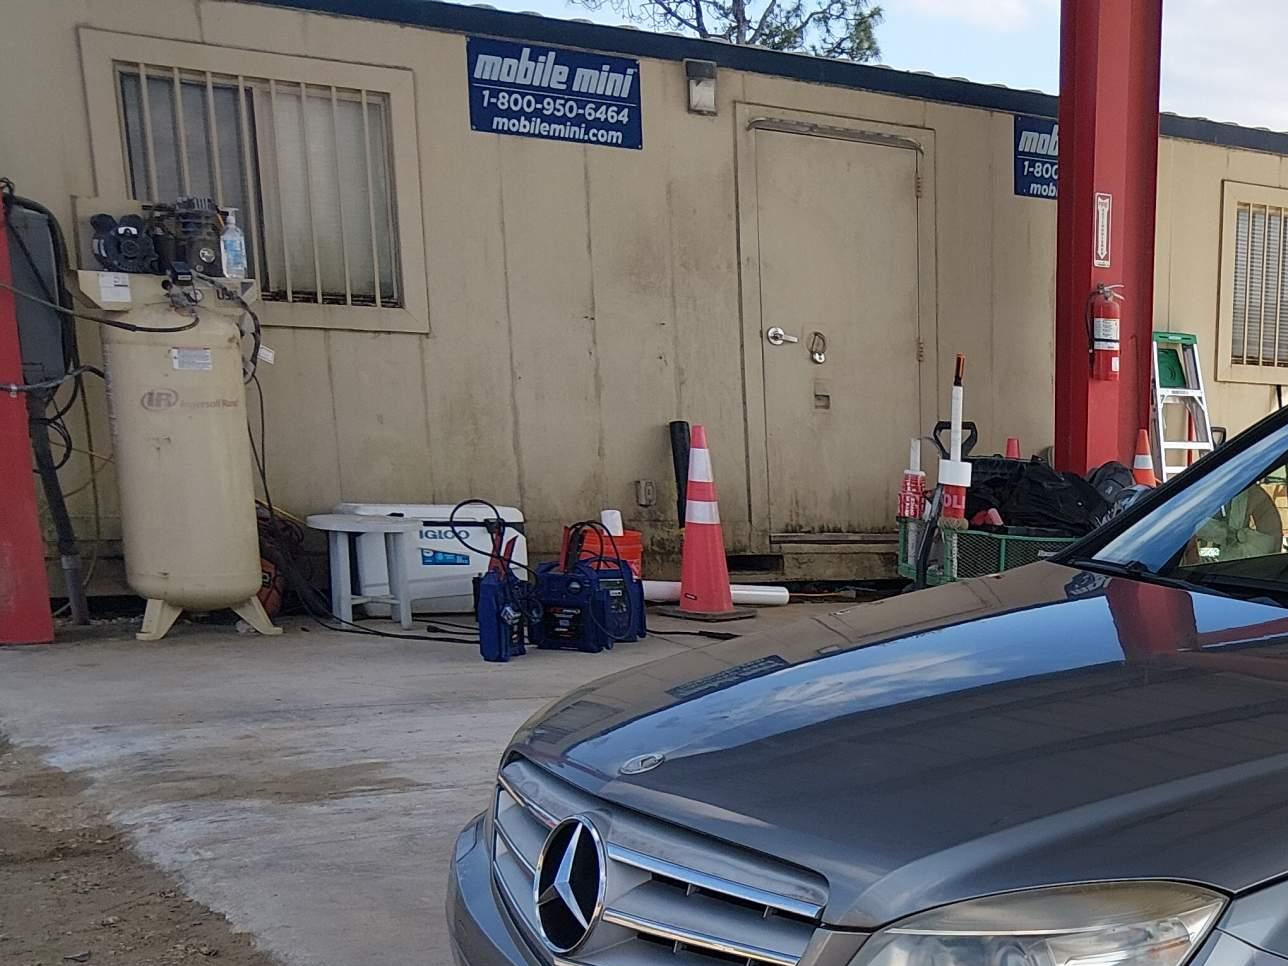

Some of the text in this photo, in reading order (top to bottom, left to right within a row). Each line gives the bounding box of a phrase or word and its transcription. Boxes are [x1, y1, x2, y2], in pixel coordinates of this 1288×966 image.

[473, 47, 635, 98] mobile mini
[482, 90, 629, 125] 1-800-950-6464
[491, 115, 623, 145] mobilemini.com
[419, 530, 470, 540] IGLOO
